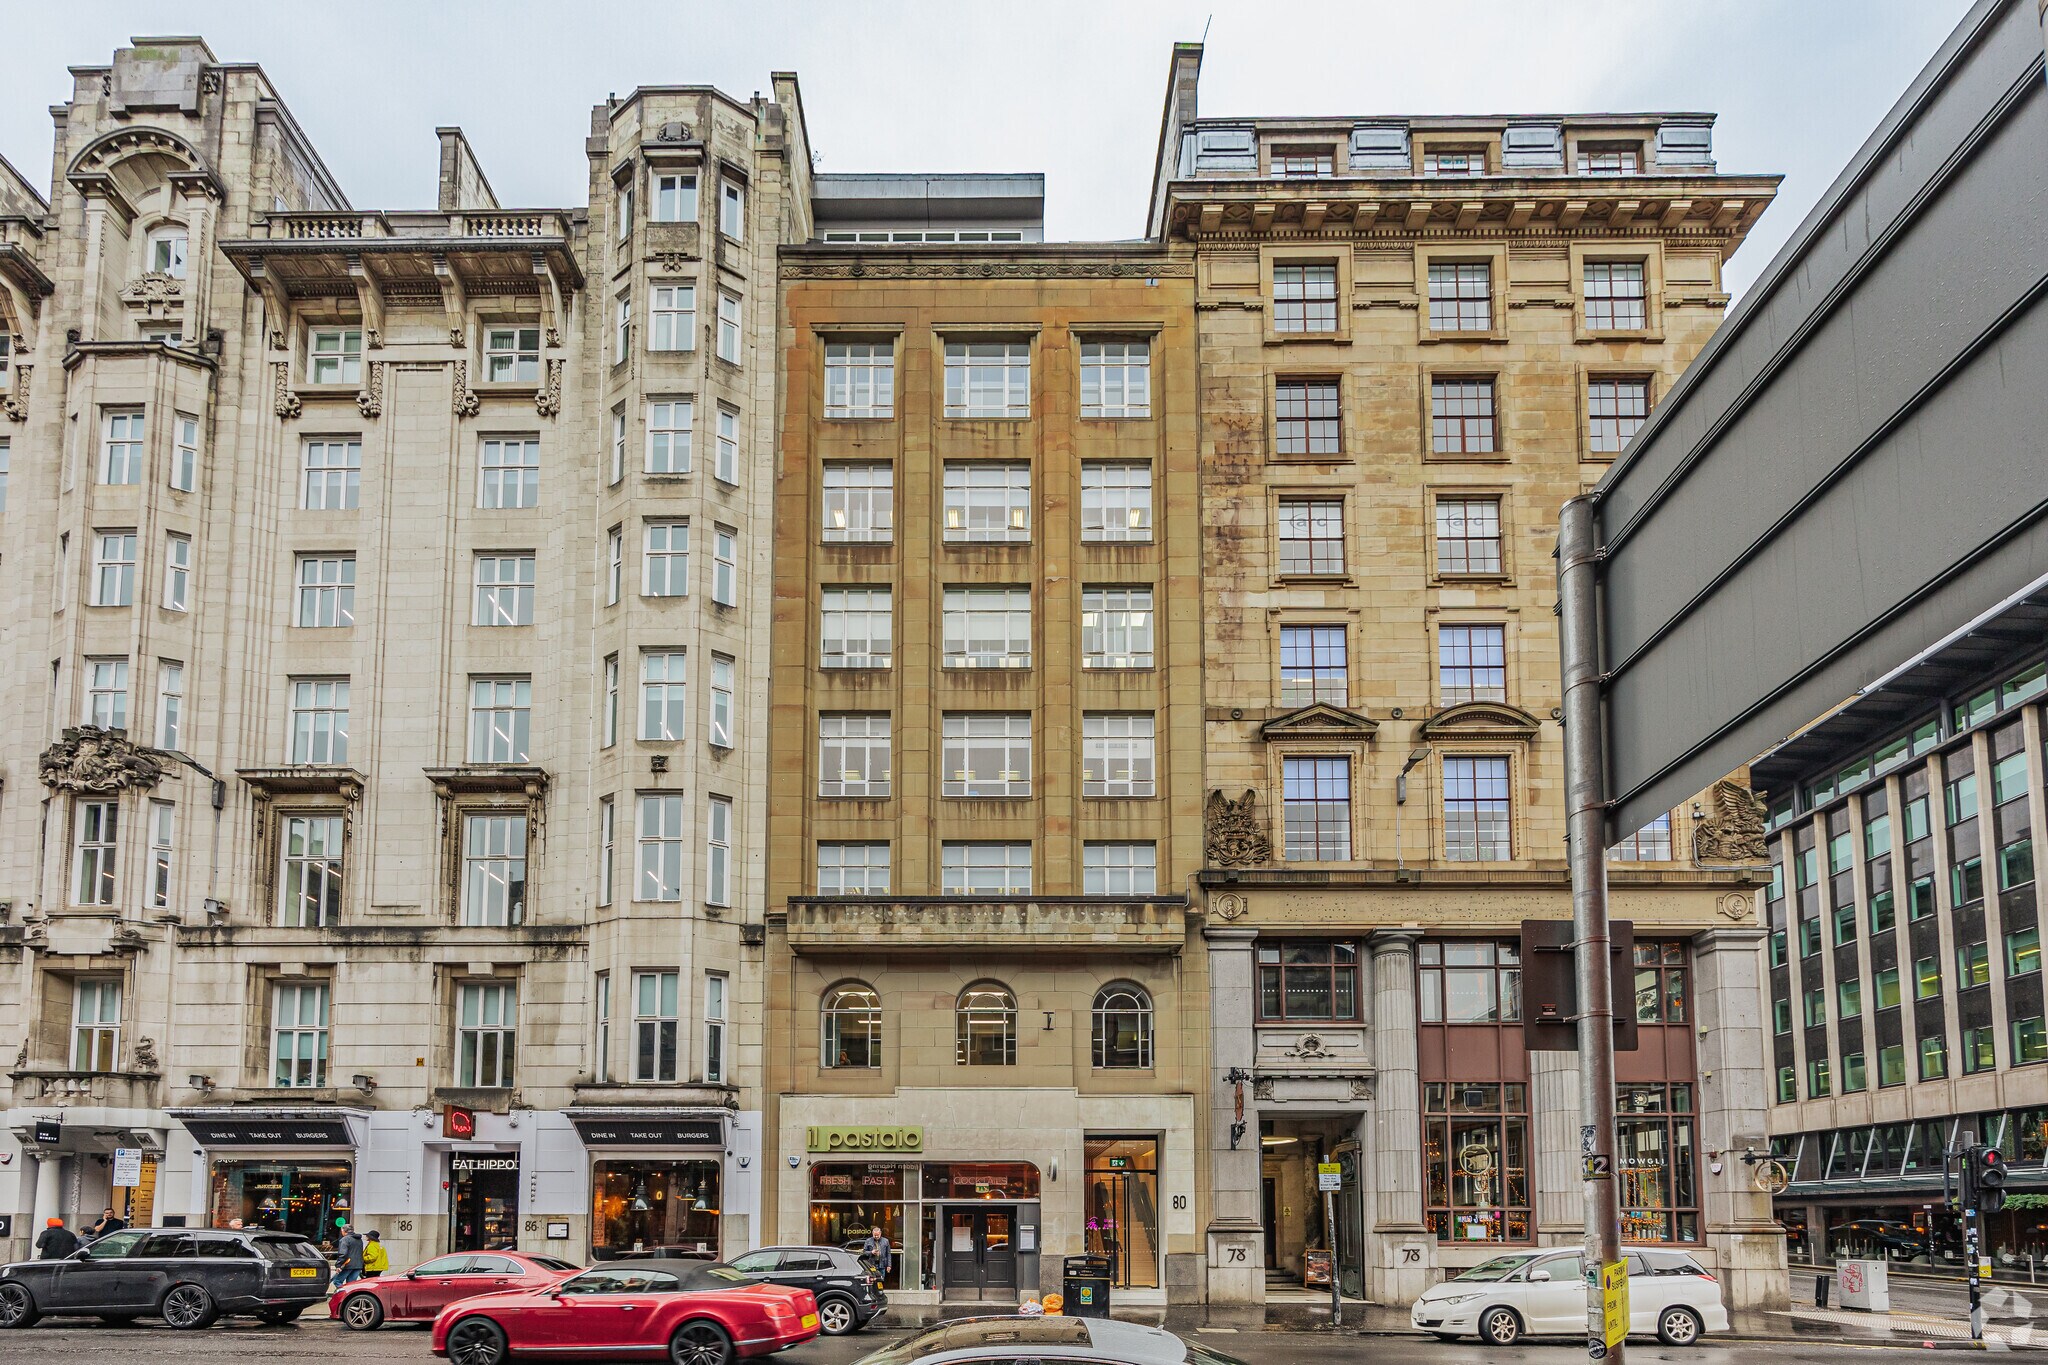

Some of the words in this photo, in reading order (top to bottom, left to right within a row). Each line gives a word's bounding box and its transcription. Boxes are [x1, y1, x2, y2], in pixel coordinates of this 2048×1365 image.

[808, 1127, 818, 1147] il
[828, 1128, 920, 1151] pastaio
[452, 1159, 475, 1170] FAT
[477, 1159, 515, 1170] HIPPO
[820, 1175, 851, 1185] FRESH
[862, 1176, 895, 1185] PASTA
[953, 1176, 1008, 1185] COCKTAILS
[1172, 1195, 1187, 1209] 80
[400, 1221, 412, 1231] 86
[525, 1221, 537, 1231] 86
[1227, 1248, 1246, 1263] 78
[1402, 1248, 1420, 1264] 78
